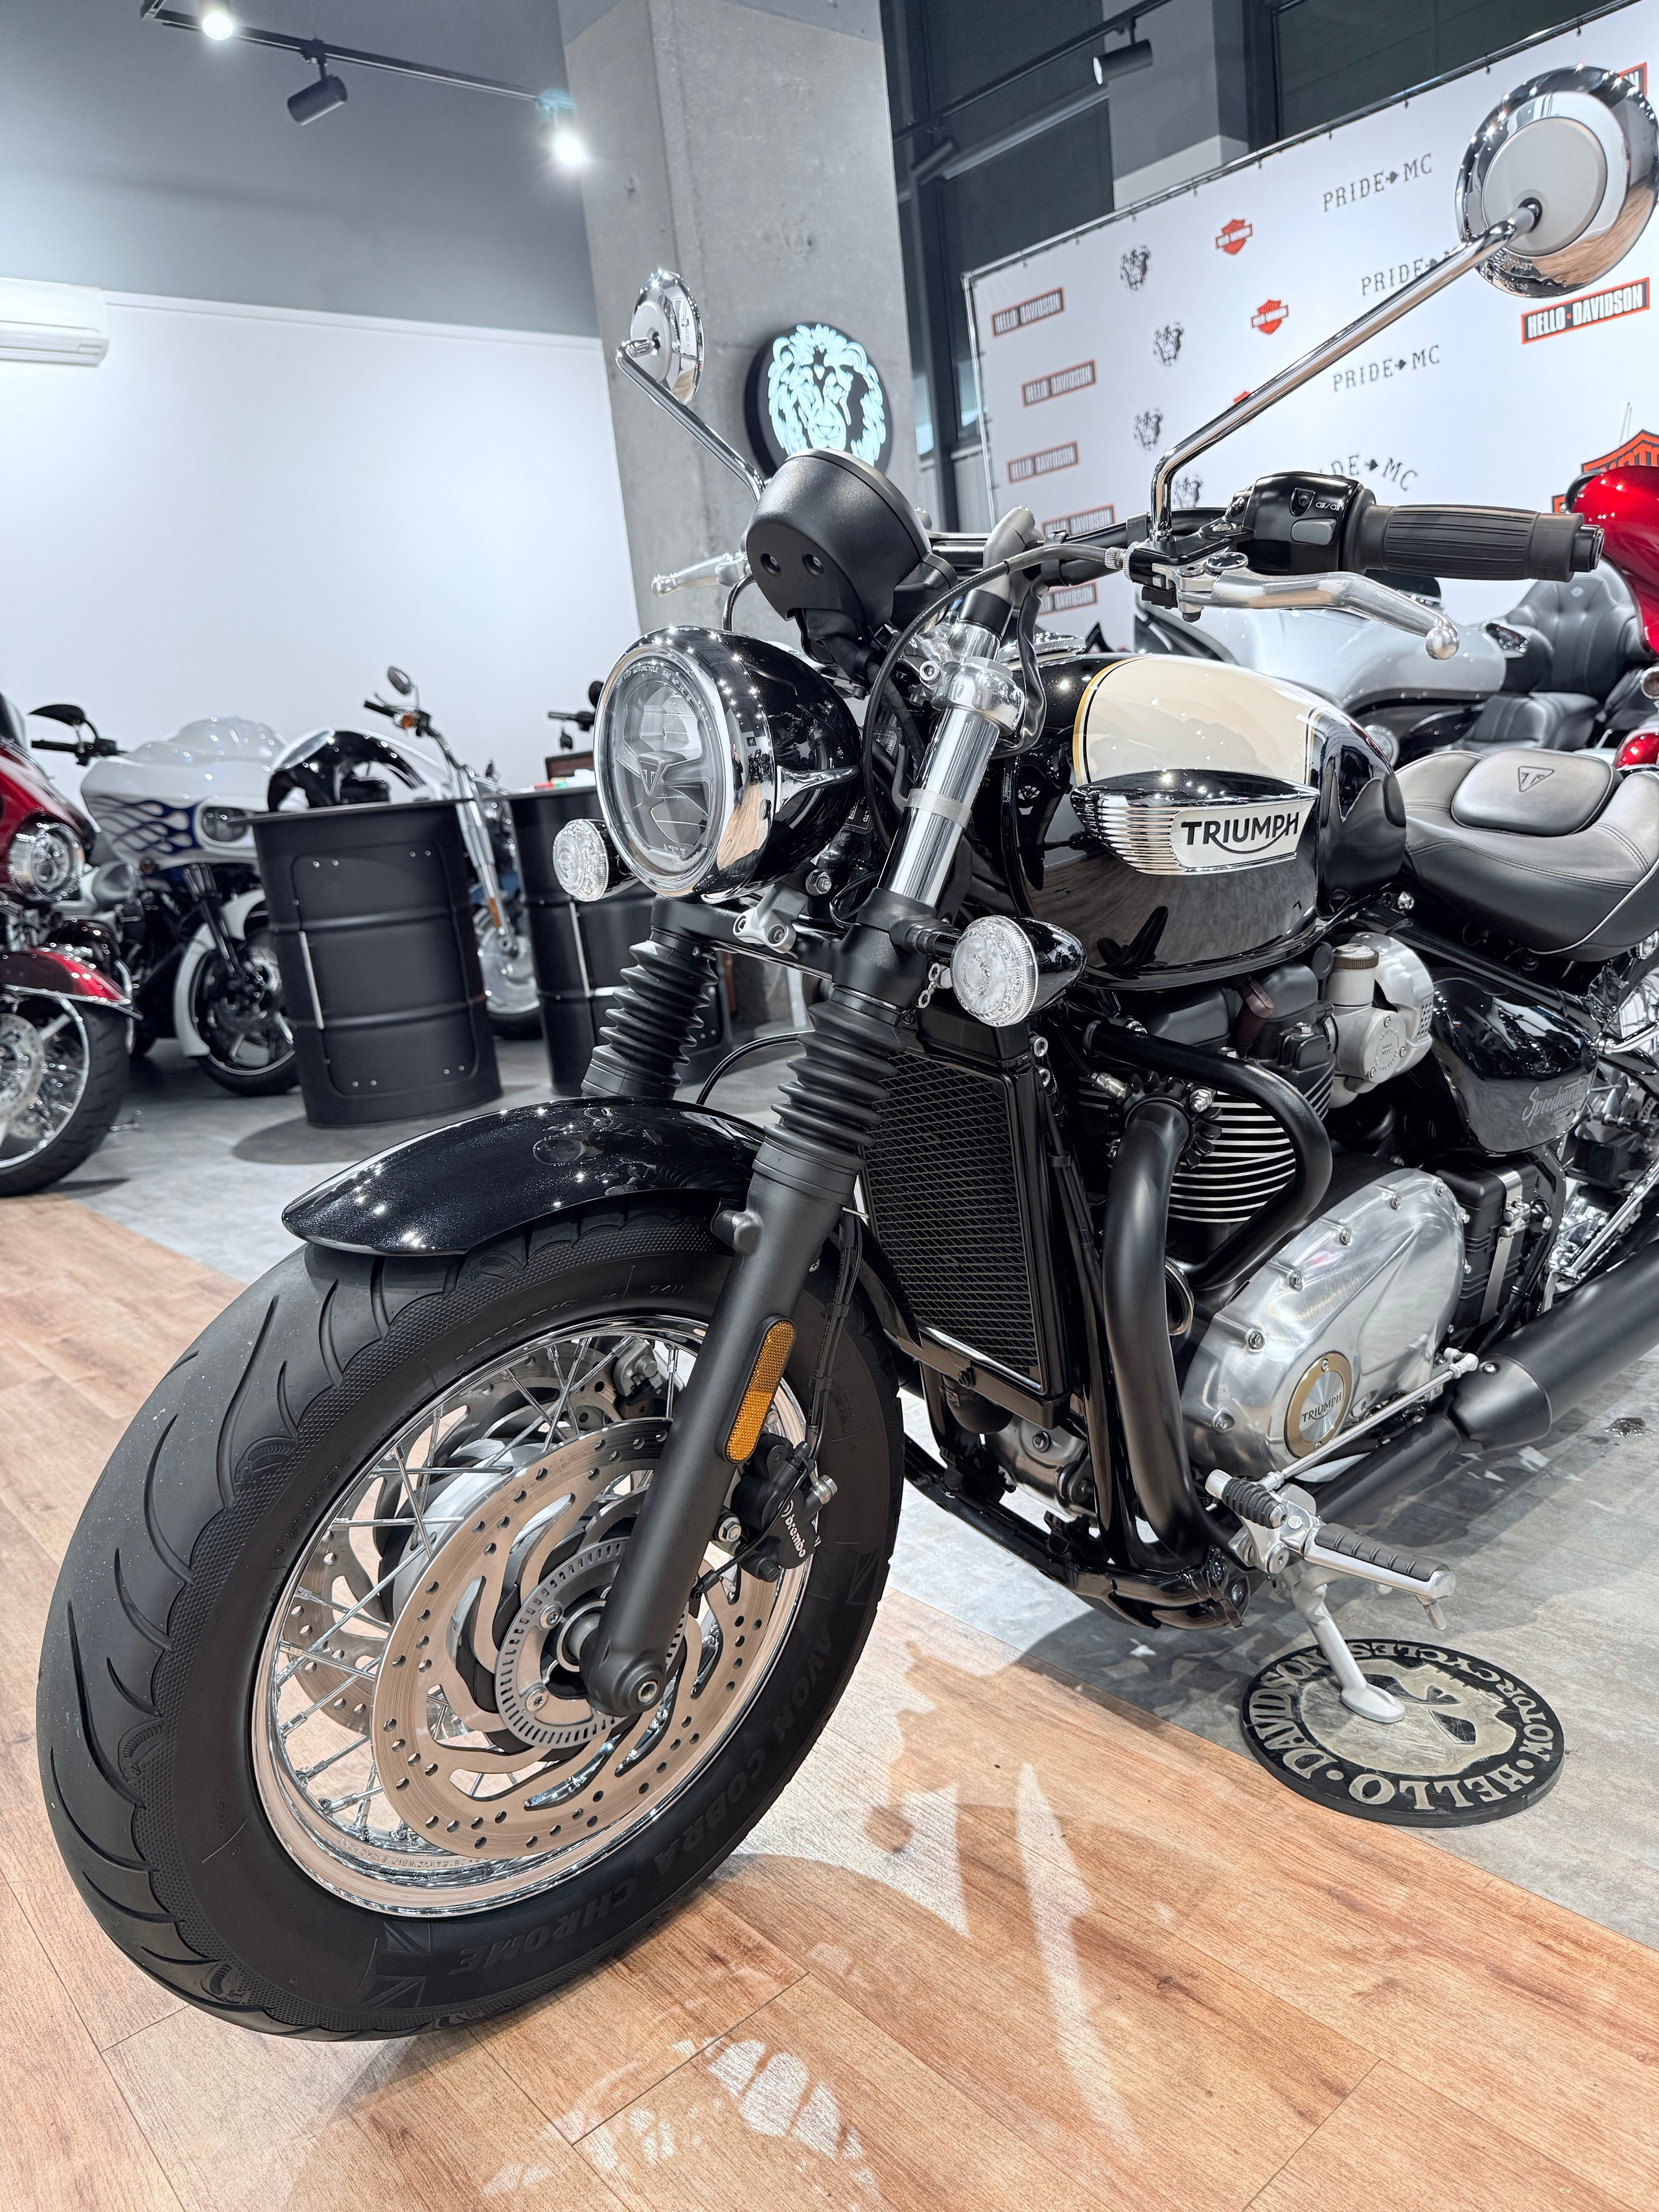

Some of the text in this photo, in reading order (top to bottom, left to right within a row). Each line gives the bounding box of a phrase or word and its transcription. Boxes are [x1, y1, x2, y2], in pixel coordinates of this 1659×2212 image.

[1323, 152, 1432, 213] PRIDE MC
[1362, 257, 1423, 296] PRIDE
[1527, 283, 1643, 339] HELLO DAVIDSON
[1333, 343, 1440, 392] PRIDE MC
[1382, 458, 1419, 491] MC
[1181, 811, 1299, 854] TRIUMPH
[1301, 1391, 1341, 1423] TRIUMPH
[785, 1513, 806, 1557] brembo
[1249, 1642, 1555, 1810] HELLO DAVIDSON MOTORCYCLES
[448, 1621, 831, 1975] AVON COBRA CHROME
